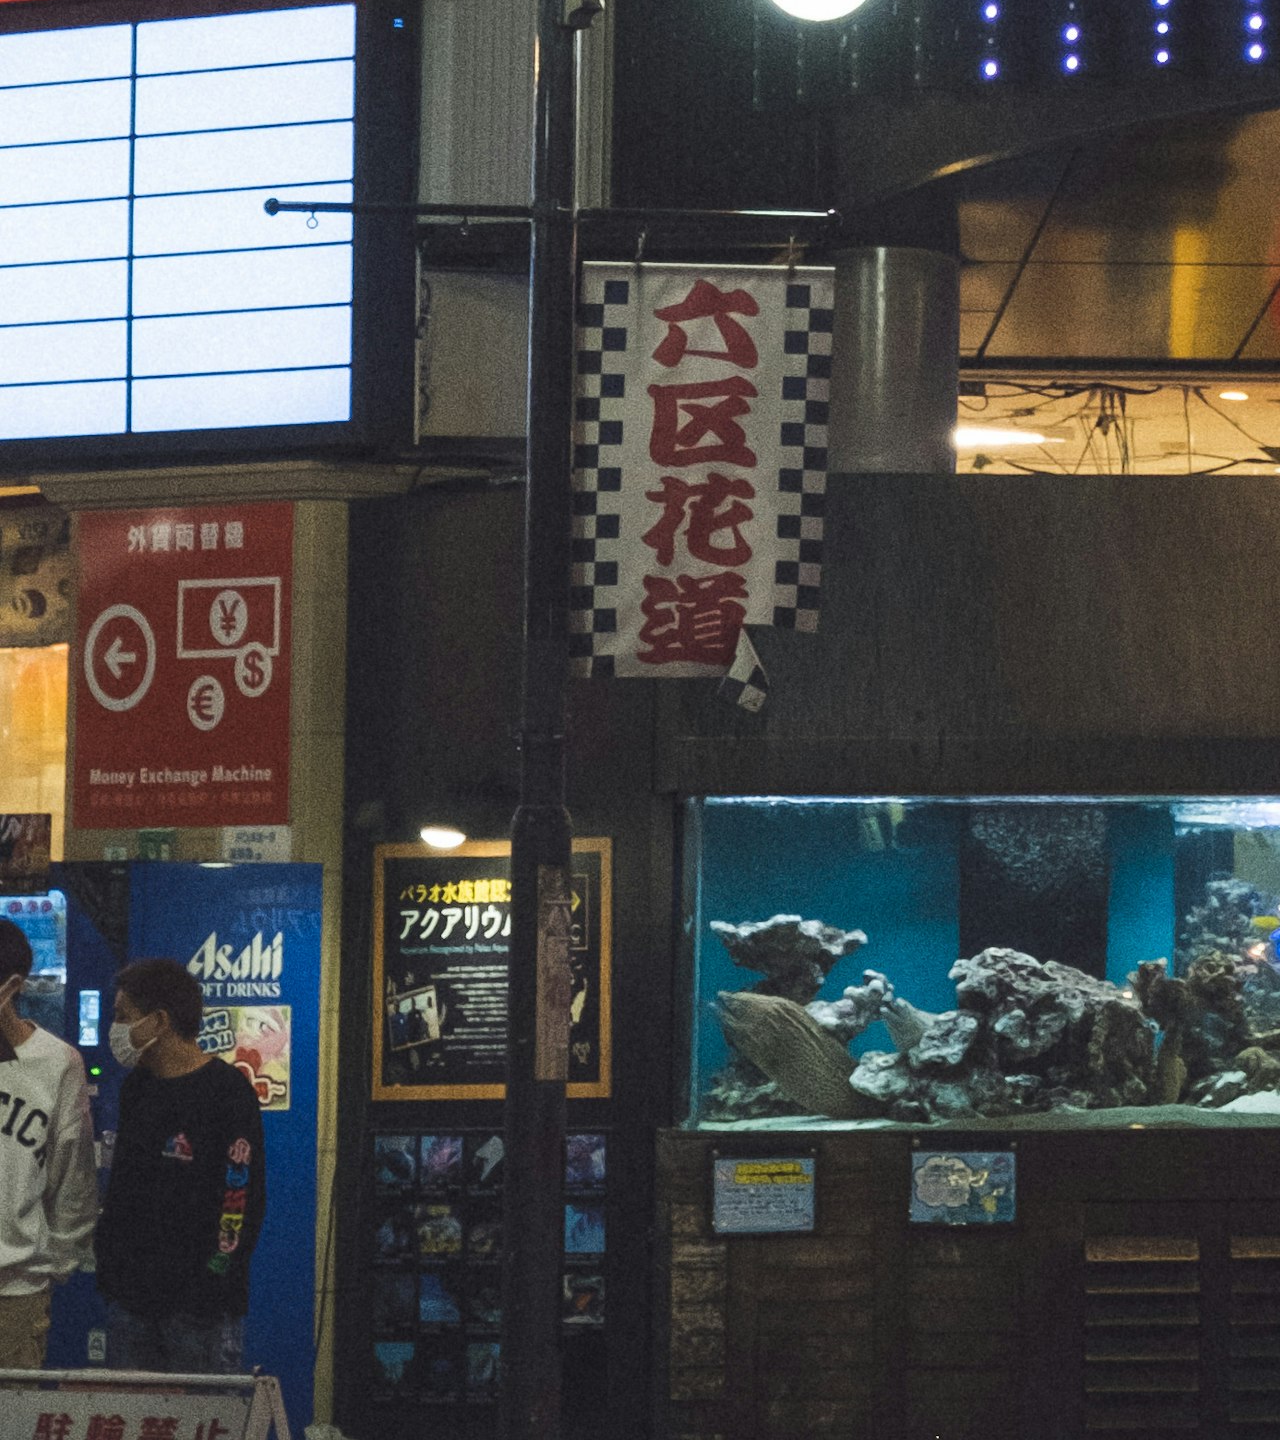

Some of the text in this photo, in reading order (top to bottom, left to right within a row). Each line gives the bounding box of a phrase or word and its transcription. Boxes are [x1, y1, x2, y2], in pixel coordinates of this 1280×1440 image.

[637, 278, 761, 666] 六区花道
[89, 765, 273, 788] Money Exchange Machine
[187, 931, 284, 981] Asahi
[227, 981, 281, 998] DRINKS
